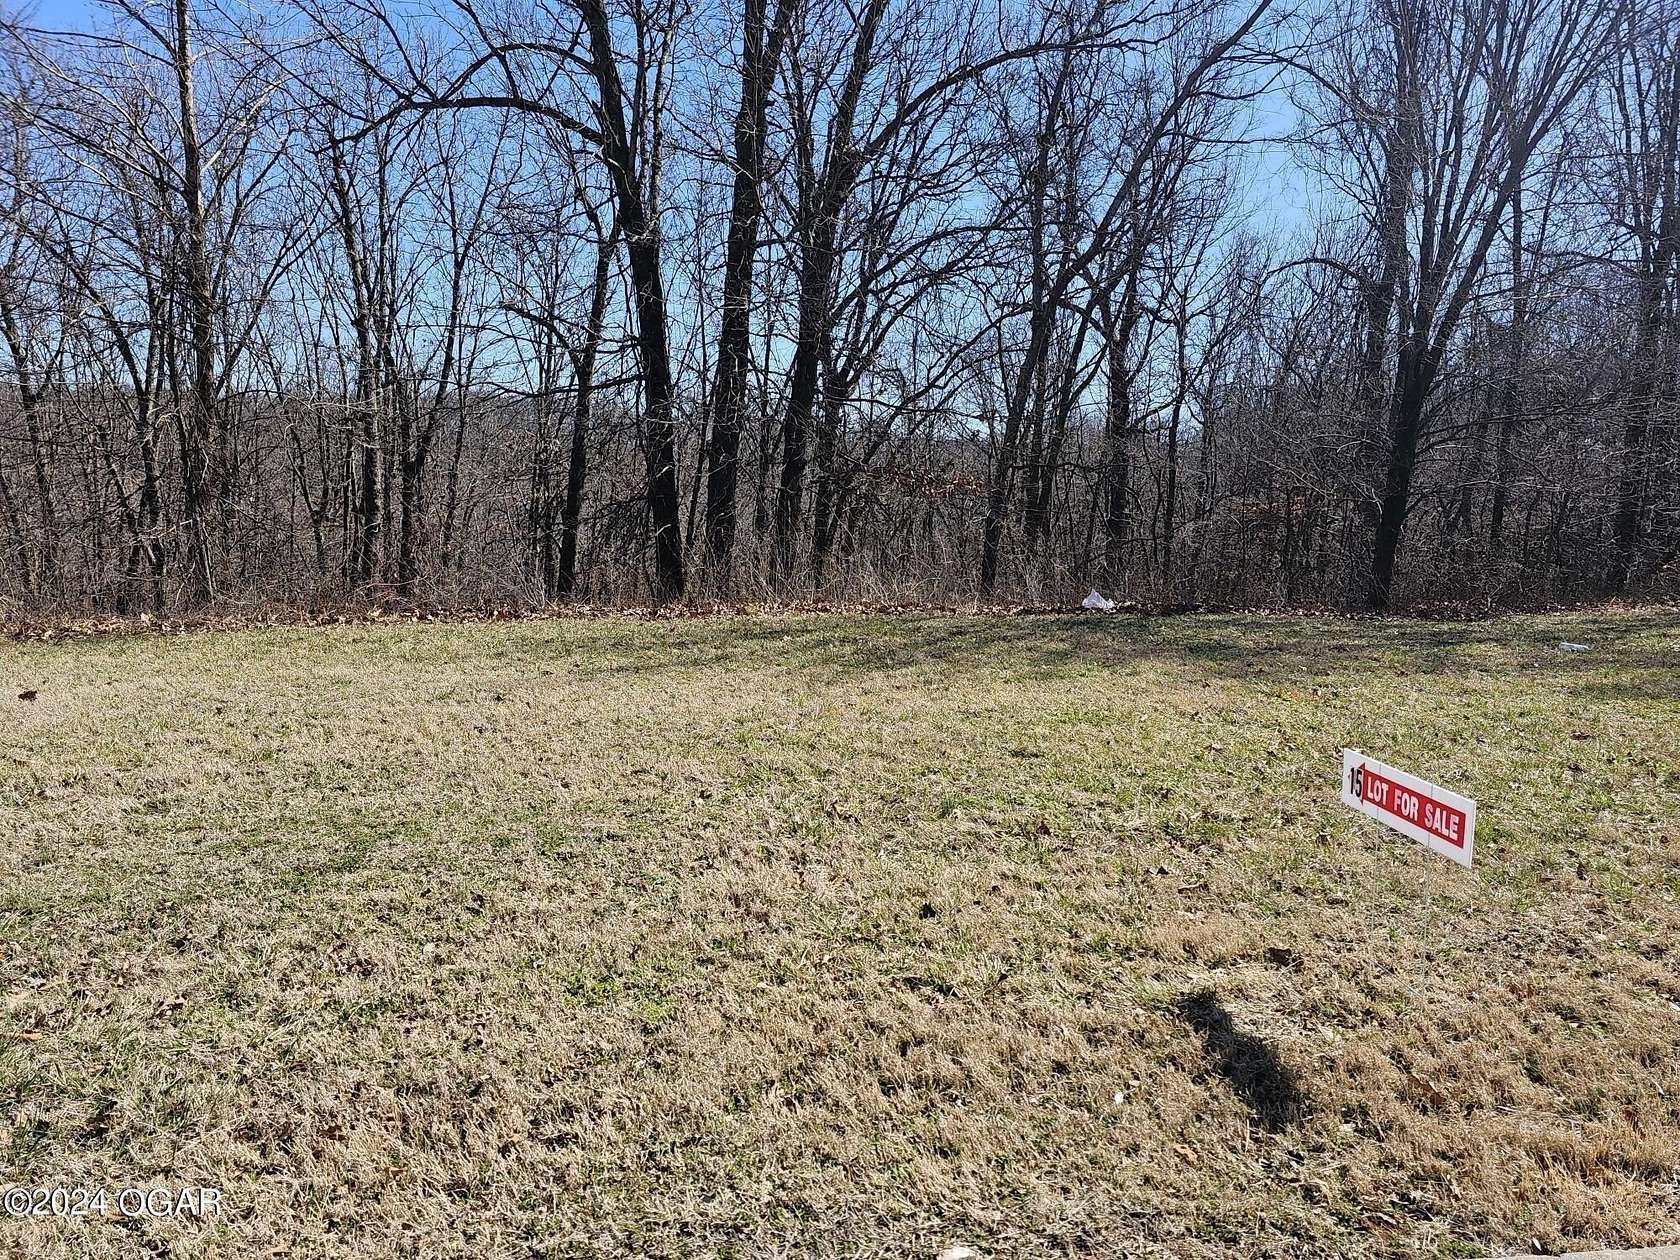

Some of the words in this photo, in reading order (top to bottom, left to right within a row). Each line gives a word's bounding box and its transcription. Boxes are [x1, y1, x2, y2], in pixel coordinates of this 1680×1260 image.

[1350, 767, 1362, 798] 15
[1367, 776, 1389, 806] LOT
[1393, 788, 1419, 821] FOR
[1424, 803, 1460, 841] SALE
